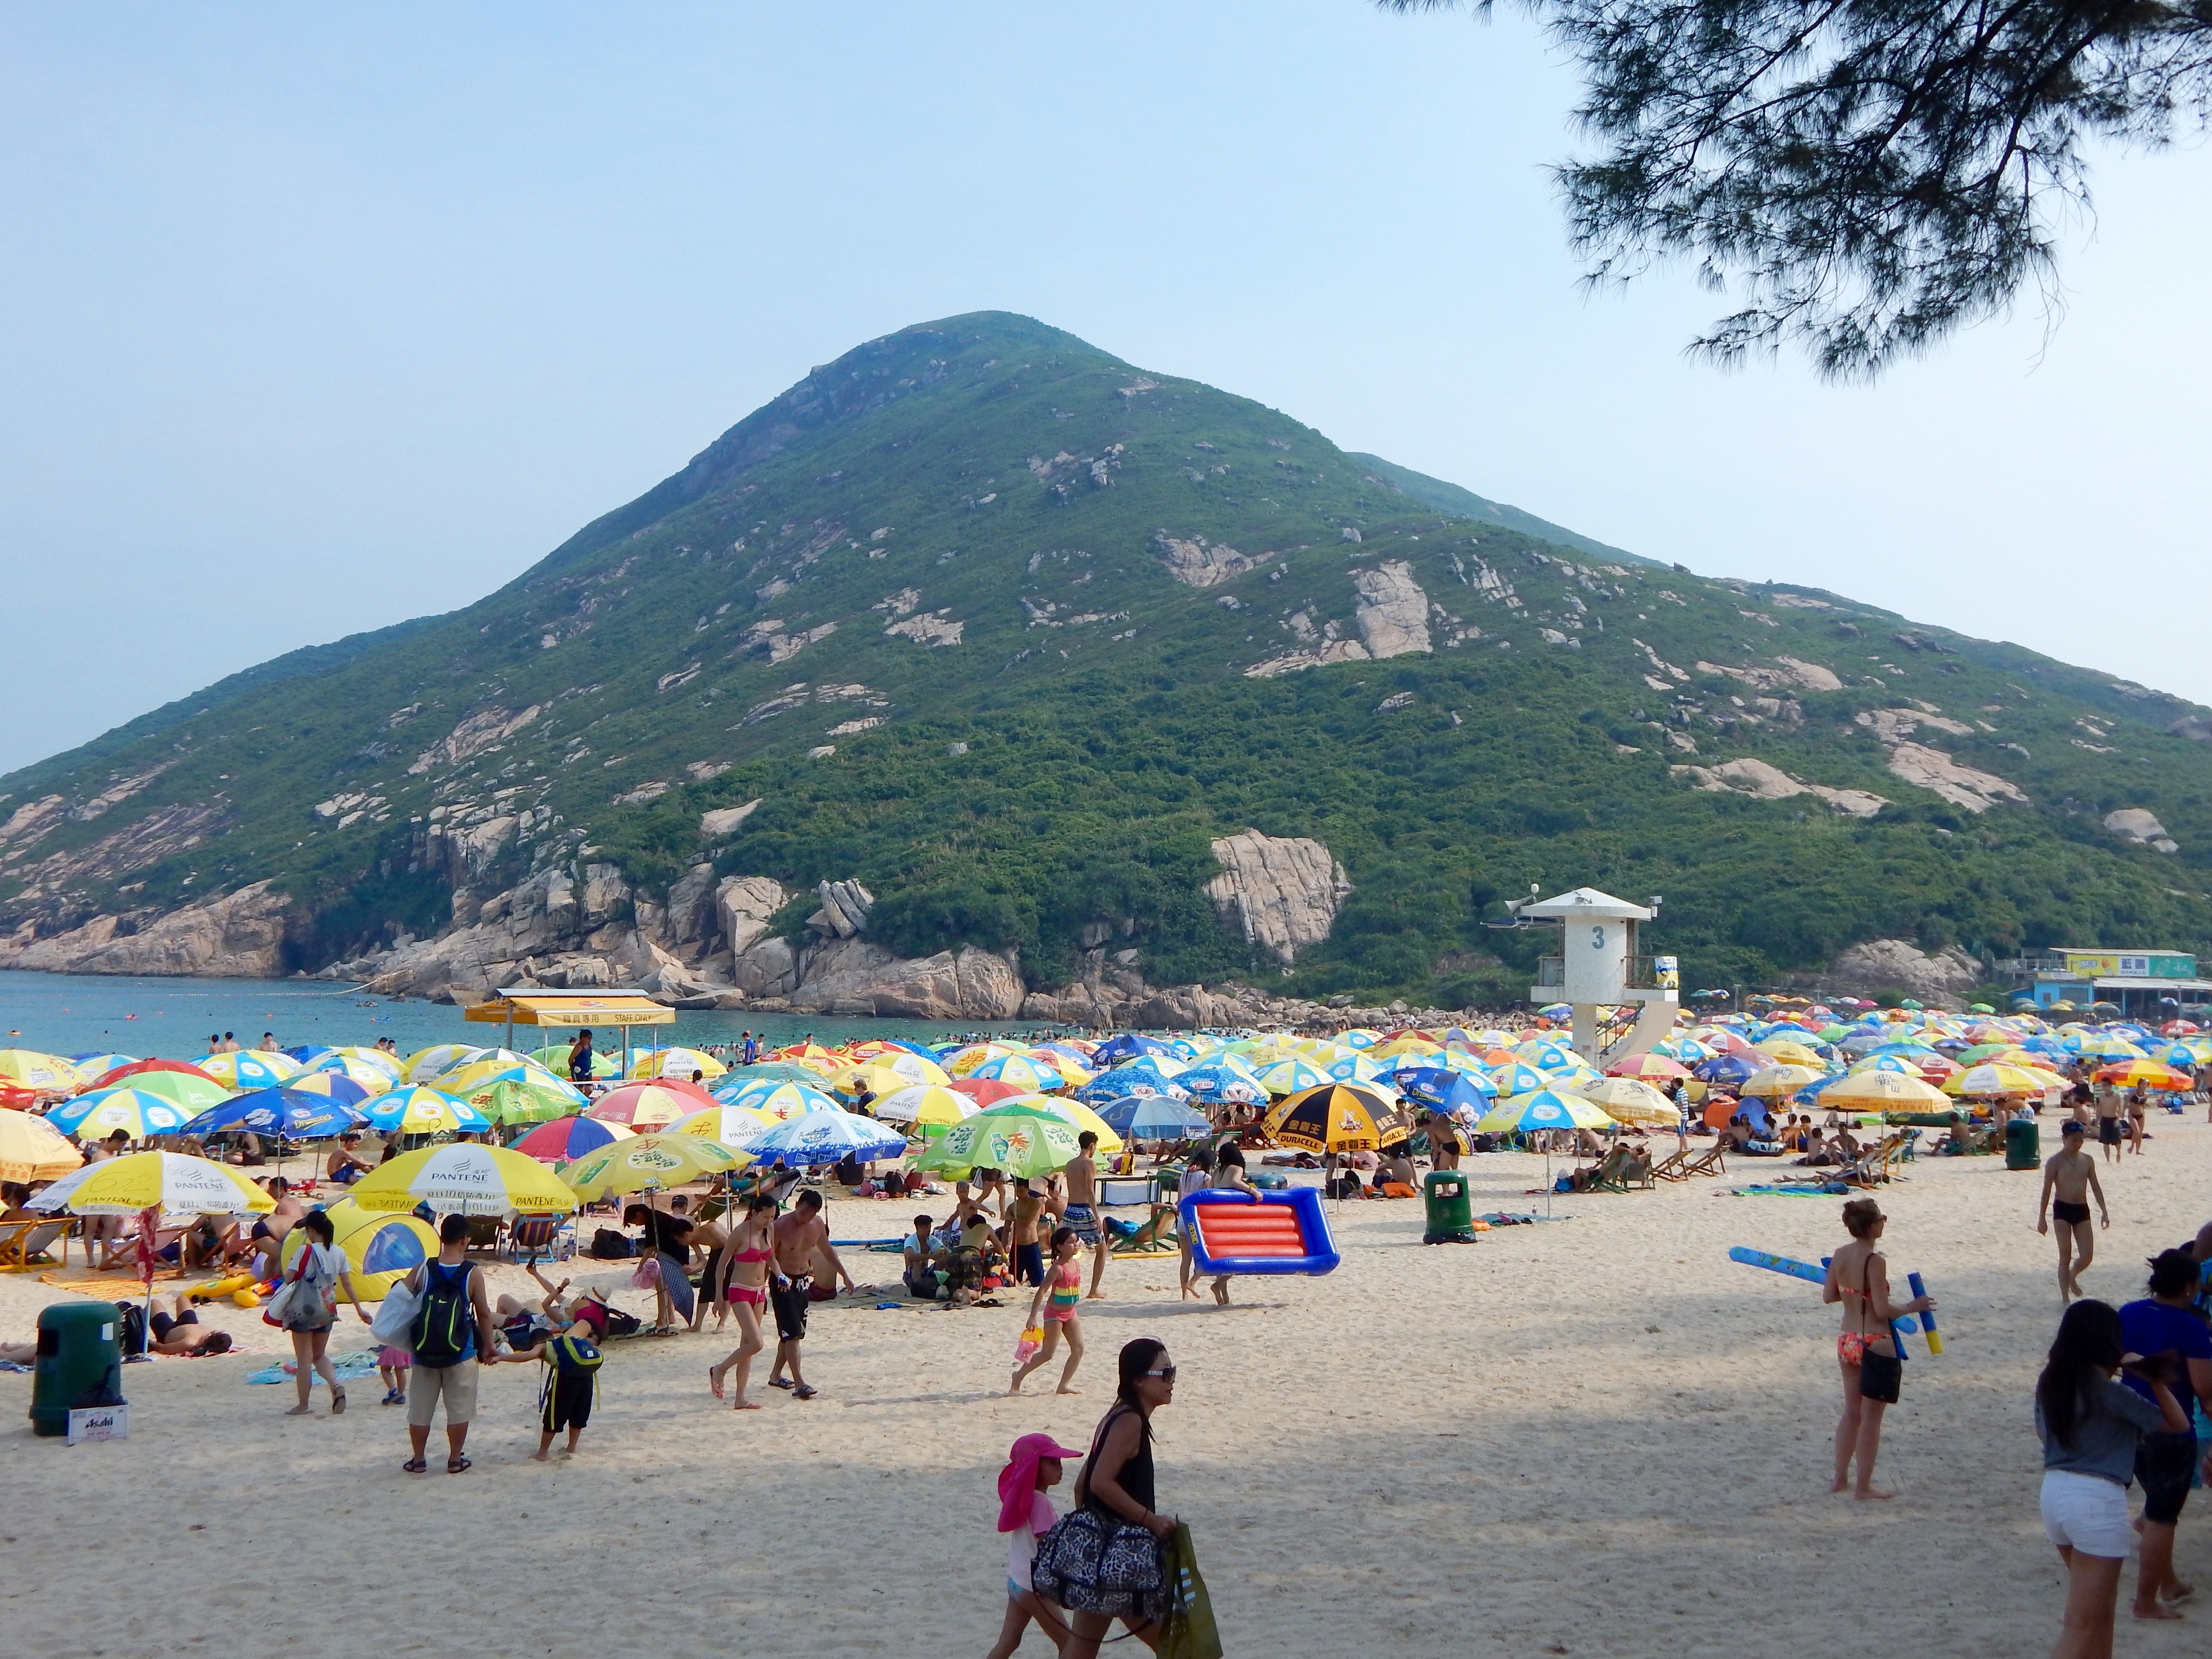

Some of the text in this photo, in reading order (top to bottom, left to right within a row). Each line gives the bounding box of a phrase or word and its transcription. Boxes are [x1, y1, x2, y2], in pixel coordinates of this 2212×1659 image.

[1592, 926, 1604, 949] 3
[615, 1013, 652, 1022] STAFF ONLY
[1412, 1088, 1445, 1104] Drumstick
[294, 1113, 335, 1129] Drumstick
[1288, 1119, 1322, 1135] 金霸王
[1280, 1135, 1319, 1149] DURACELL
[1337, 1139, 1370, 1151] 金霸王
[432, 1173, 489, 1181] PANTENE
[516, 1196, 555, 1206] PANTENE
[85, 1416, 113, 1429] Asahi
